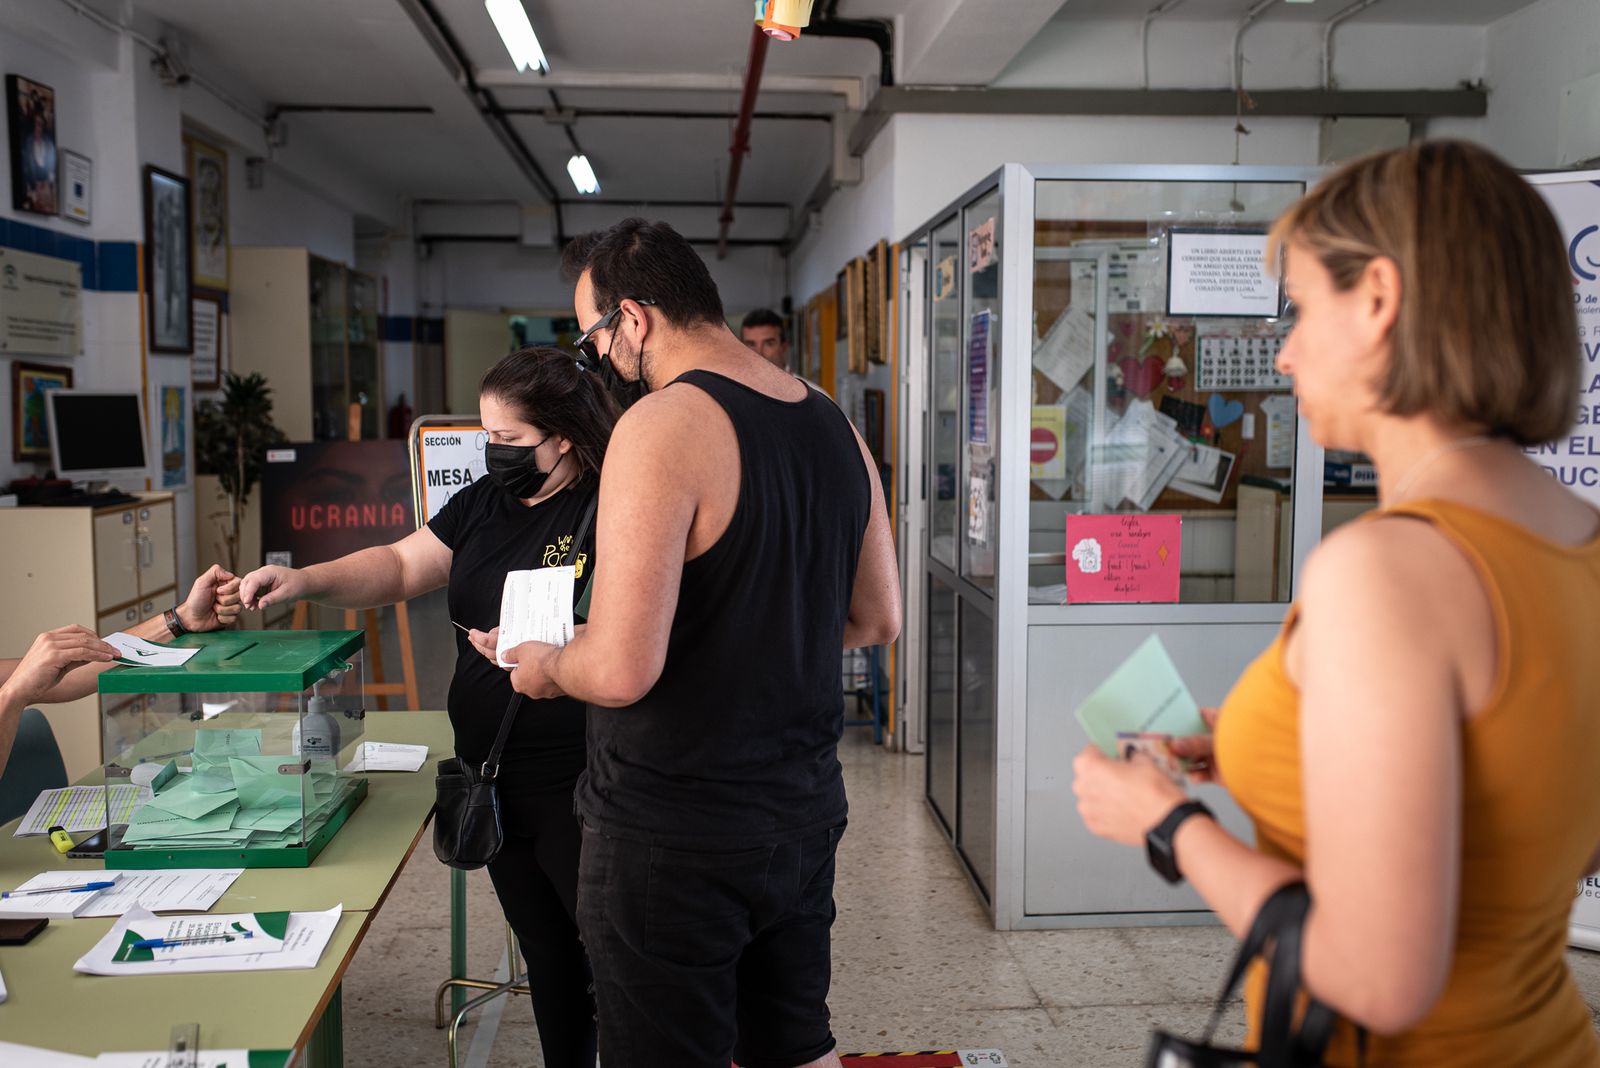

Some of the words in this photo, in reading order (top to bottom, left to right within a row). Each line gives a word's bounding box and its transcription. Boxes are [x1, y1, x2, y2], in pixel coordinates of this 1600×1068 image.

[1585, 294, 1598, 304] de
[424, 435, 462, 446] SECCIÓN
[427, 468, 474, 487] MESA
[291, 502, 406, 531] UCRANIA
